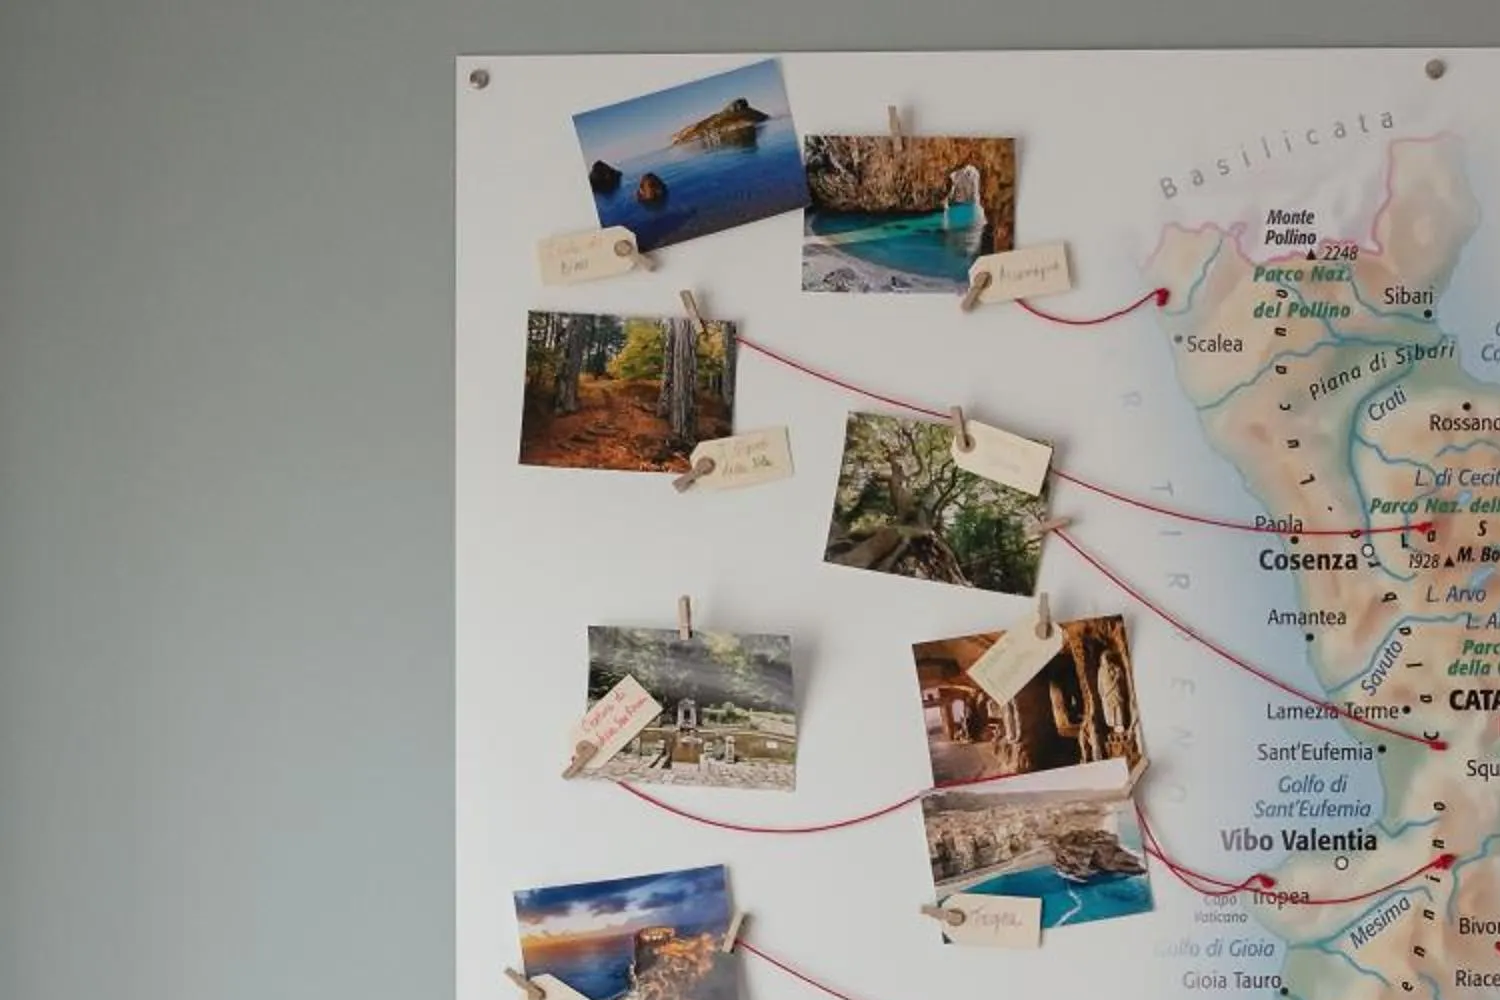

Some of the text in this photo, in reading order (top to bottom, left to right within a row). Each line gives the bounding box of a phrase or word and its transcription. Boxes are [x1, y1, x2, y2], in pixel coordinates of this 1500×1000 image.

[1159, 110, 1395, 200] Basilicata
[1266, 209, 1316, 226] Monte
[1264, 229, 1317, 246] Pollino
[1323, 245, 1359, 261] 2248
[1253, 266, 1351, 283] Parco Naz.
[1383, 287, 1434, 306] Sibari
[1253, 302, 1351, 319] del Pollino
[1186, 335, 1244, 353] Scalea
[1308, 341, 1456, 401] Piana di Sibari
[1367, 386, 1408, 422] Crati
[1415, 469, 1429, 487] L.
[1435, 468, 1451, 487] di
[1370, 499, 1418, 515] Parco
[1425, 499, 1463, 514] Naz.
[1254, 515, 1304, 533] Paola
[1259, 549, 1359, 572] Cosenza
[1408, 553, 1440, 570] 1928
[1456, 547, 1476, 563] M.
[1426, 586, 1487, 603] L. Arvo
[1267, 608, 1347, 627] Amantea
[1465, 614, 1479, 631] L.
[1361, 639, 1404, 697] Savuto
[1448, 659, 1491, 676] della
[1266, 702, 1400, 721] Lamezia Terme
[1257, 743, 1374, 762] Sant'Eufemia
[1277, 775, 1348, 794] Golfo di
[1253, 799, 1372, 819] Sant'Eufemia
[1219, 828, 1378, 851] Vibo Valentia
[1253, 888, 1311, 910] Tropea
[1348, 895, 1412, 950] Mesima
[1205, 938, 1225, 958] di
[1229, 939, 1276, 958] Gioia
[1182, 971, 1282, 990] Gioia Tauro
